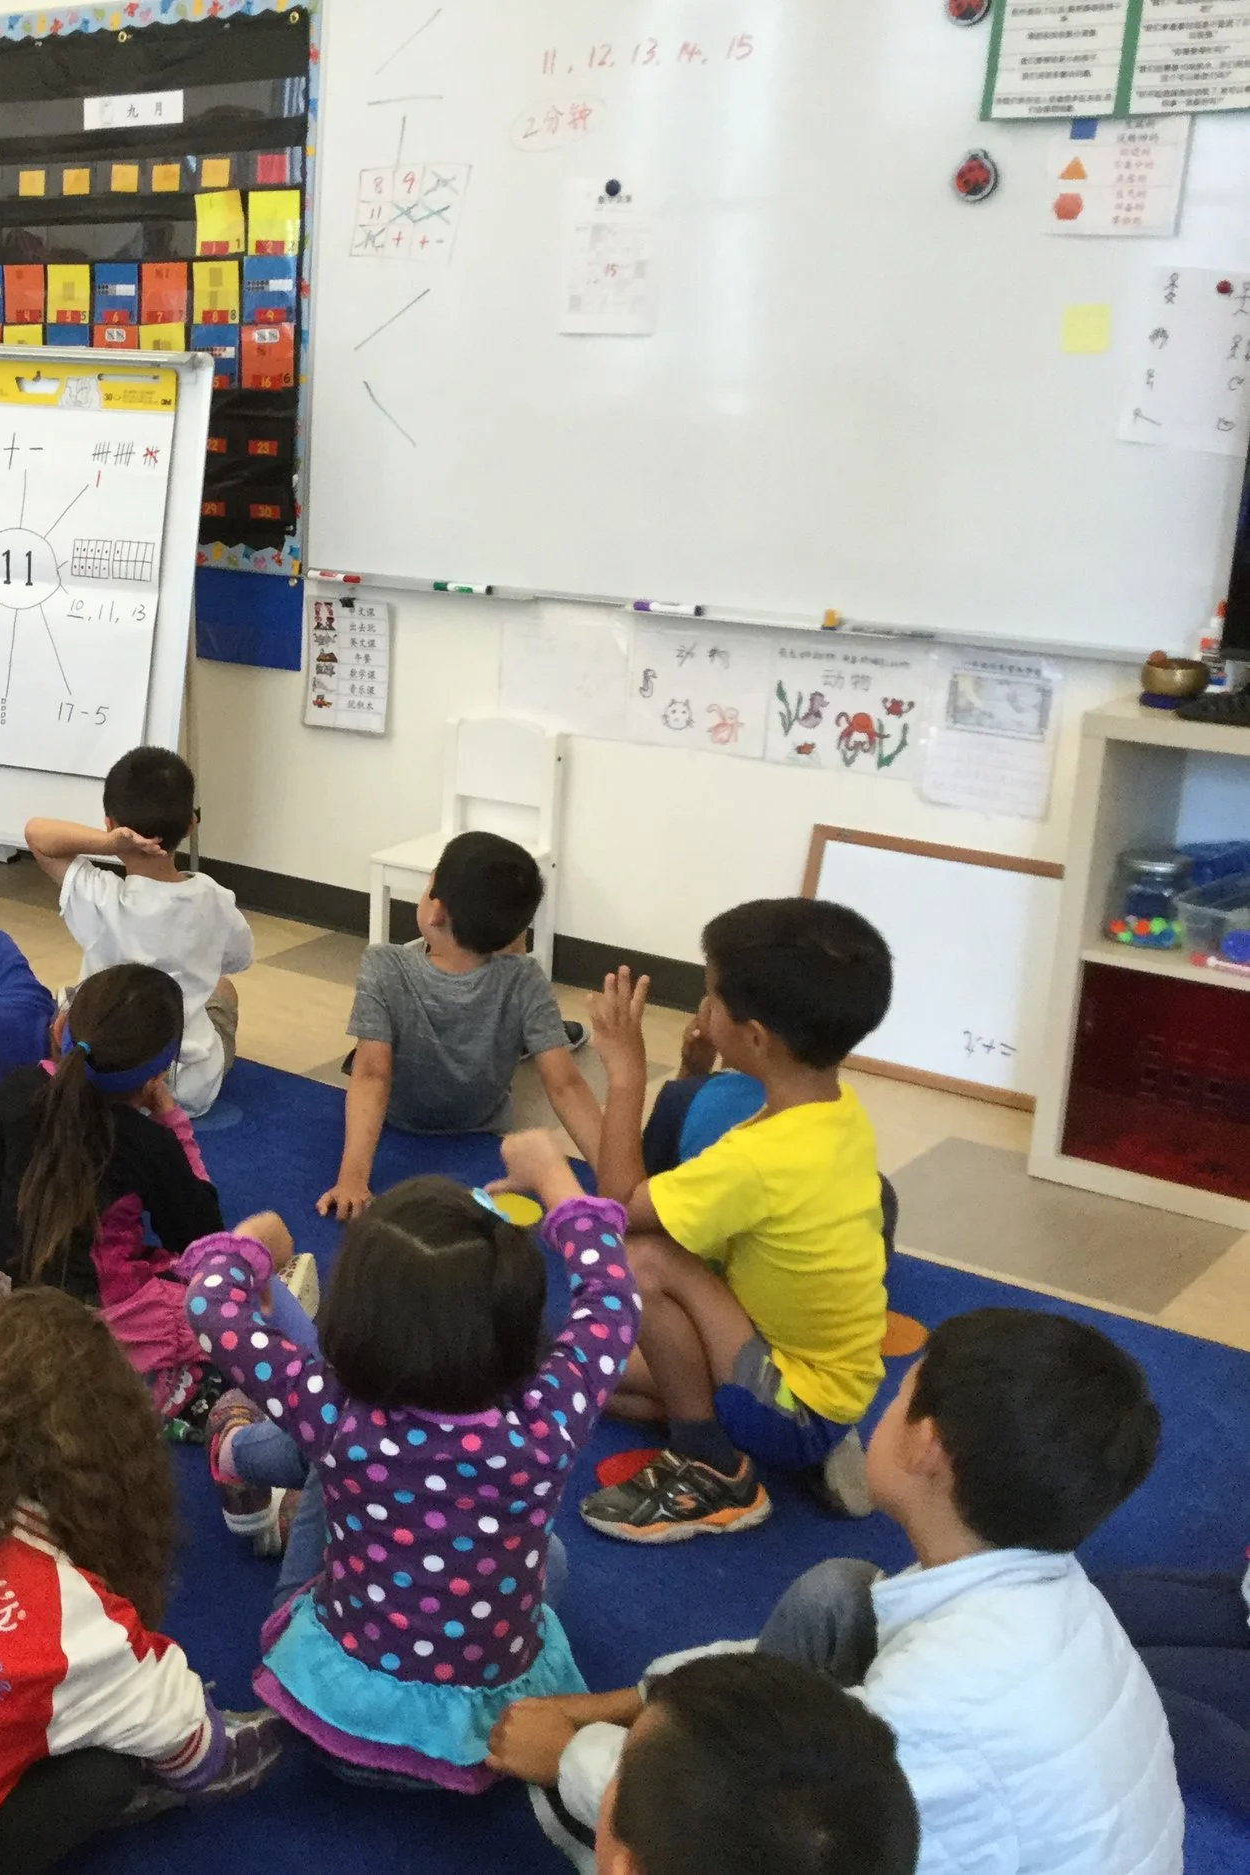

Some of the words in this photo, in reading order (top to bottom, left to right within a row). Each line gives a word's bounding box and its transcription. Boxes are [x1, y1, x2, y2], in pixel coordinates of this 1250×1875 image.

[725, 33, 755, 61] 15
[126, 101, 163, 119] 九月
[373, 175, 384, 195] 8
[402, 170, 416, 194] 9
[370, 206, 382, 220] 11
[261, 376, 272, 388] 16
[160, 398, 172, 406] 3M
[257, 442, 270, 454] 23
[205, 502, 217, 514] 29
[258, 504, 272, 518] 30
[1, 549, 34, 587] 11
